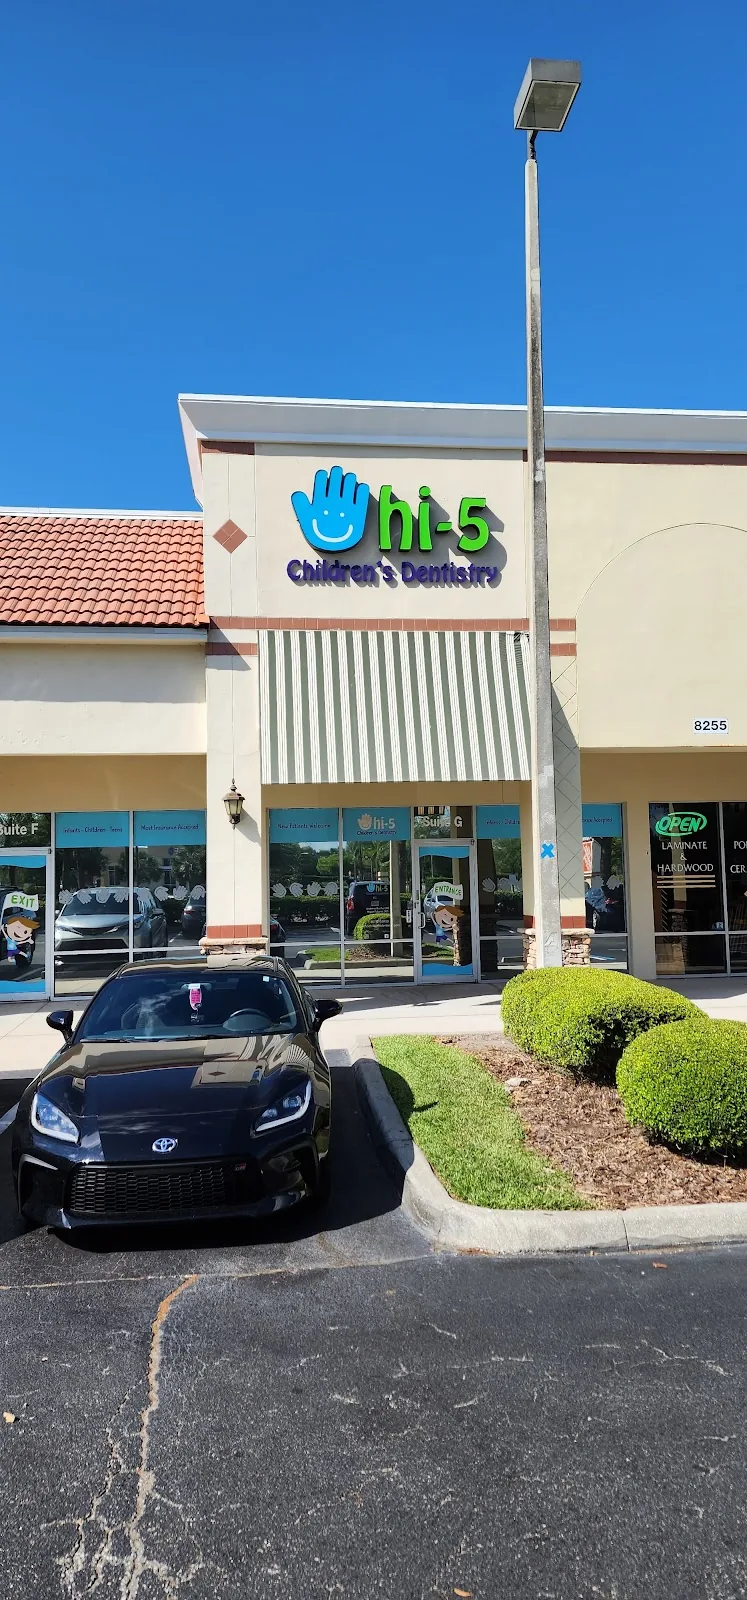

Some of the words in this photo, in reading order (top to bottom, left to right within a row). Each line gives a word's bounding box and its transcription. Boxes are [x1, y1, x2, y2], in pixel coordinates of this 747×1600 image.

[378, 485, 490, 552] hi-5
[286, 559, 393, 583] Children's
[401, 561, 499, 584] Dentistry
[694, 720, 727, 731] 8255
[373, 816, 396, 830] hi-5
[422, 816, 450, 827] Suite
[454, 815, 463, 828] G
[659, 815, 702, 832] OPEN
[31, 822, 39, 835] F
[661, 841, 708, 850] LAMINATE
[680, 852, 688, 861] &
[657, 863, 714, 873] HARDWOOD
[11, 894, 36, 908] EXIT
